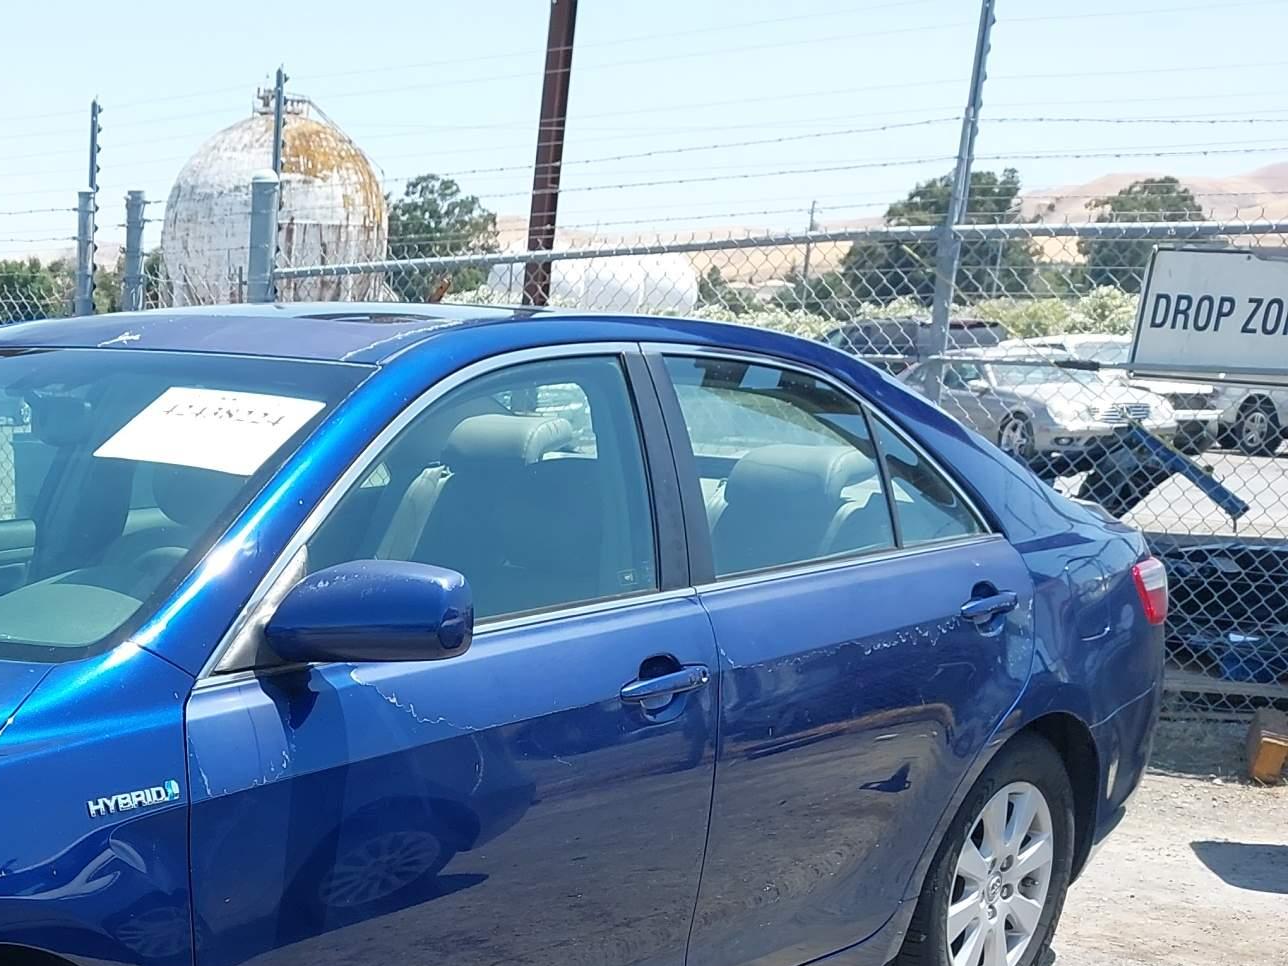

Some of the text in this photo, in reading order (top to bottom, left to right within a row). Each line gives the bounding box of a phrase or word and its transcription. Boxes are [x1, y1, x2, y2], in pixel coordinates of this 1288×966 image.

[1149, 293, 1288, 336] DROP ZO
[87, 786, 167, 818] HYBRID
